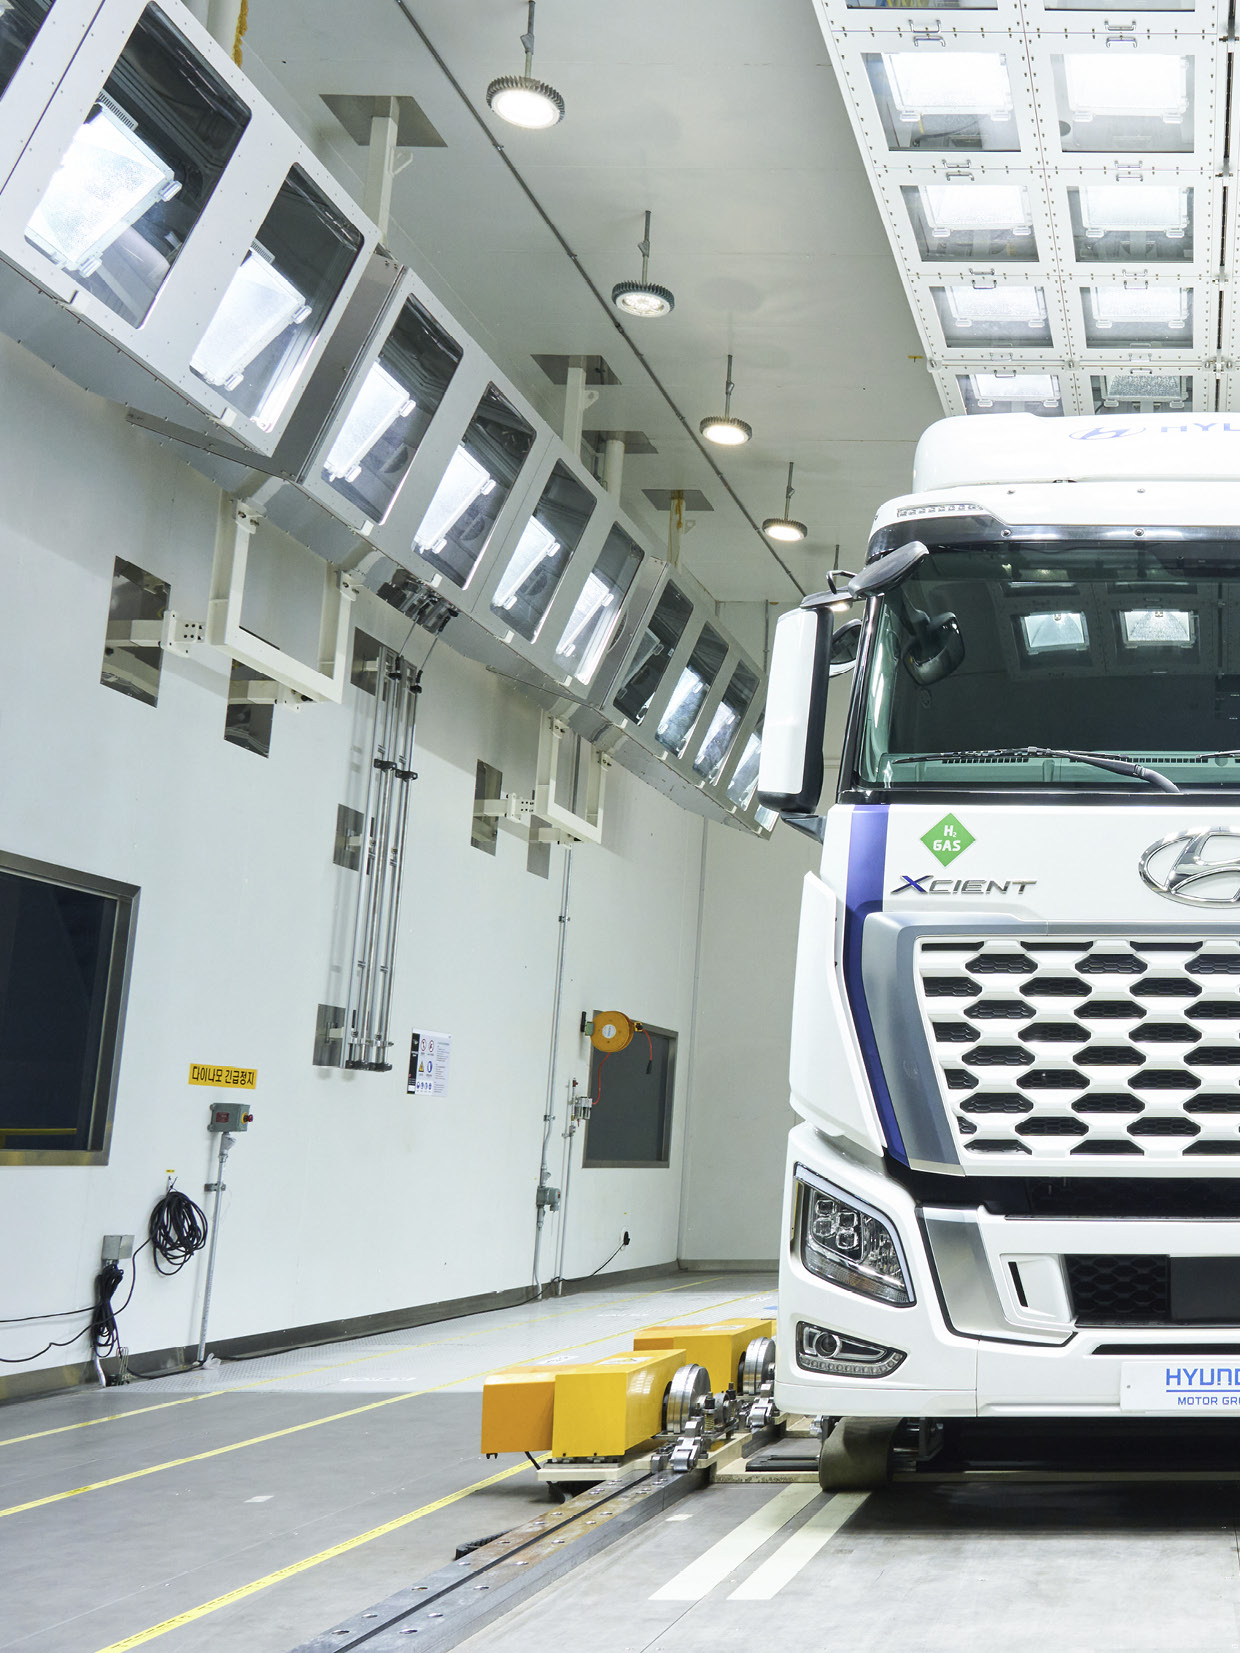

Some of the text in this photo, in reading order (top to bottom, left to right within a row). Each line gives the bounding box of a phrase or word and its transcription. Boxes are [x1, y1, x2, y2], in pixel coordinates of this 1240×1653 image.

[932, 839, 961, 851] GAS
[890, 875, 1037, 895] XCIENT
[192, 1065, 255, 1085] 다이나모 긴급정지
[1177, 1396, 1218, 1405] MOTOR
